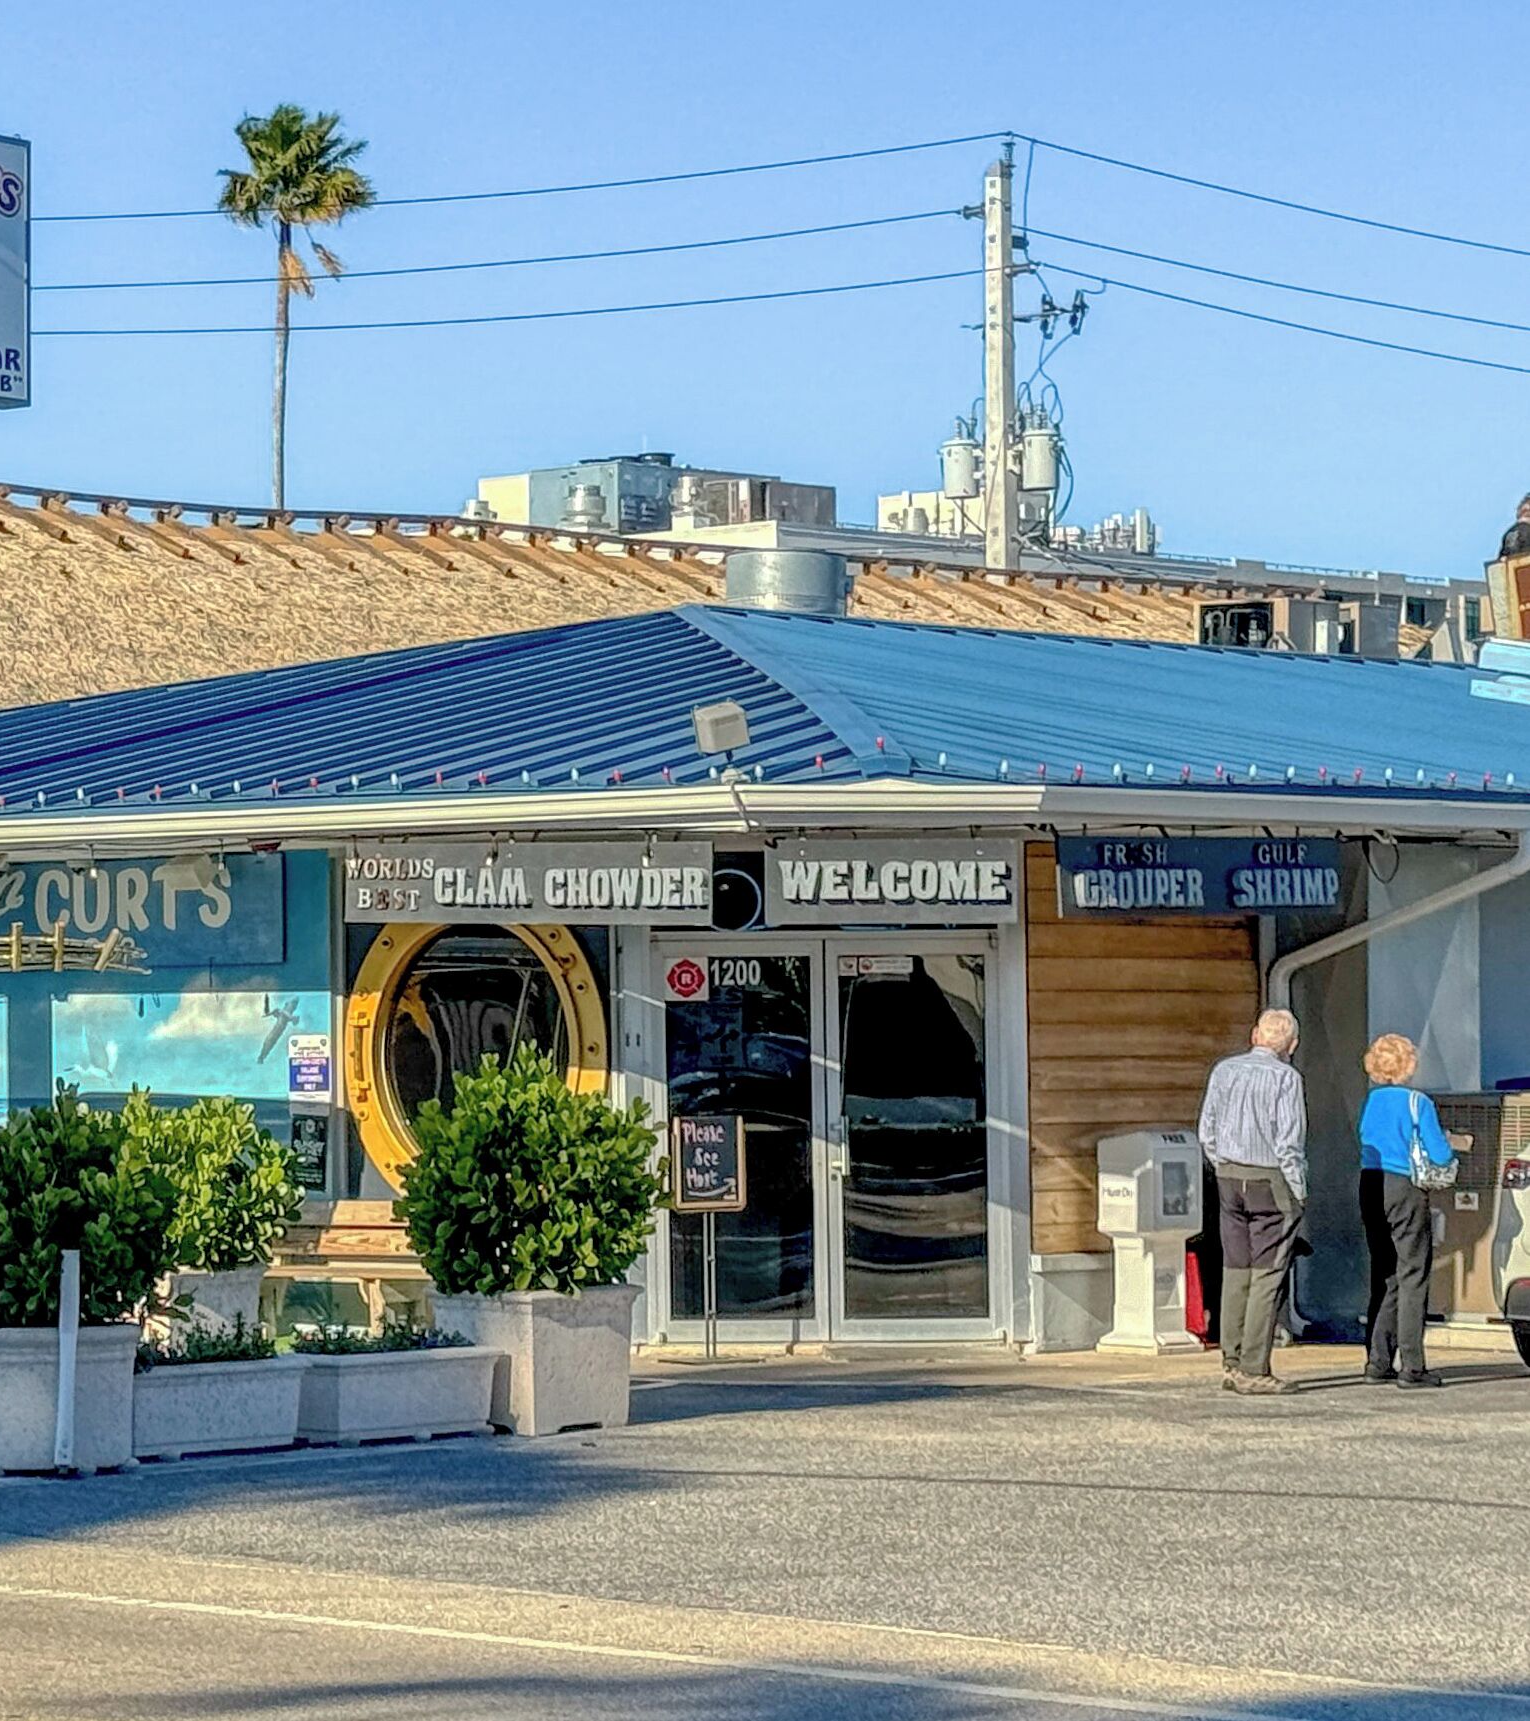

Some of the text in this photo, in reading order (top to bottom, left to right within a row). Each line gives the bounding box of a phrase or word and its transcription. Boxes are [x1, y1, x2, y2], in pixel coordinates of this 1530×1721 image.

[1258, 843, 1307, 865] GULF
[345, 855, 434, 881] WORLDS
[434, 867, 710, 909] CLAM CHOWDER
[778, 860, 1012, 904] WELCOME
[1074, 867, 1339, 909] GROUPER SHRIMP
[357, 887, 420, 912] BEST
[709, 959, 761, 987] 1200
[681, 1120, 725, 1145] Please
[694, 1147, 720, 1166] See
[685, 1167, 719, 1189] Host
